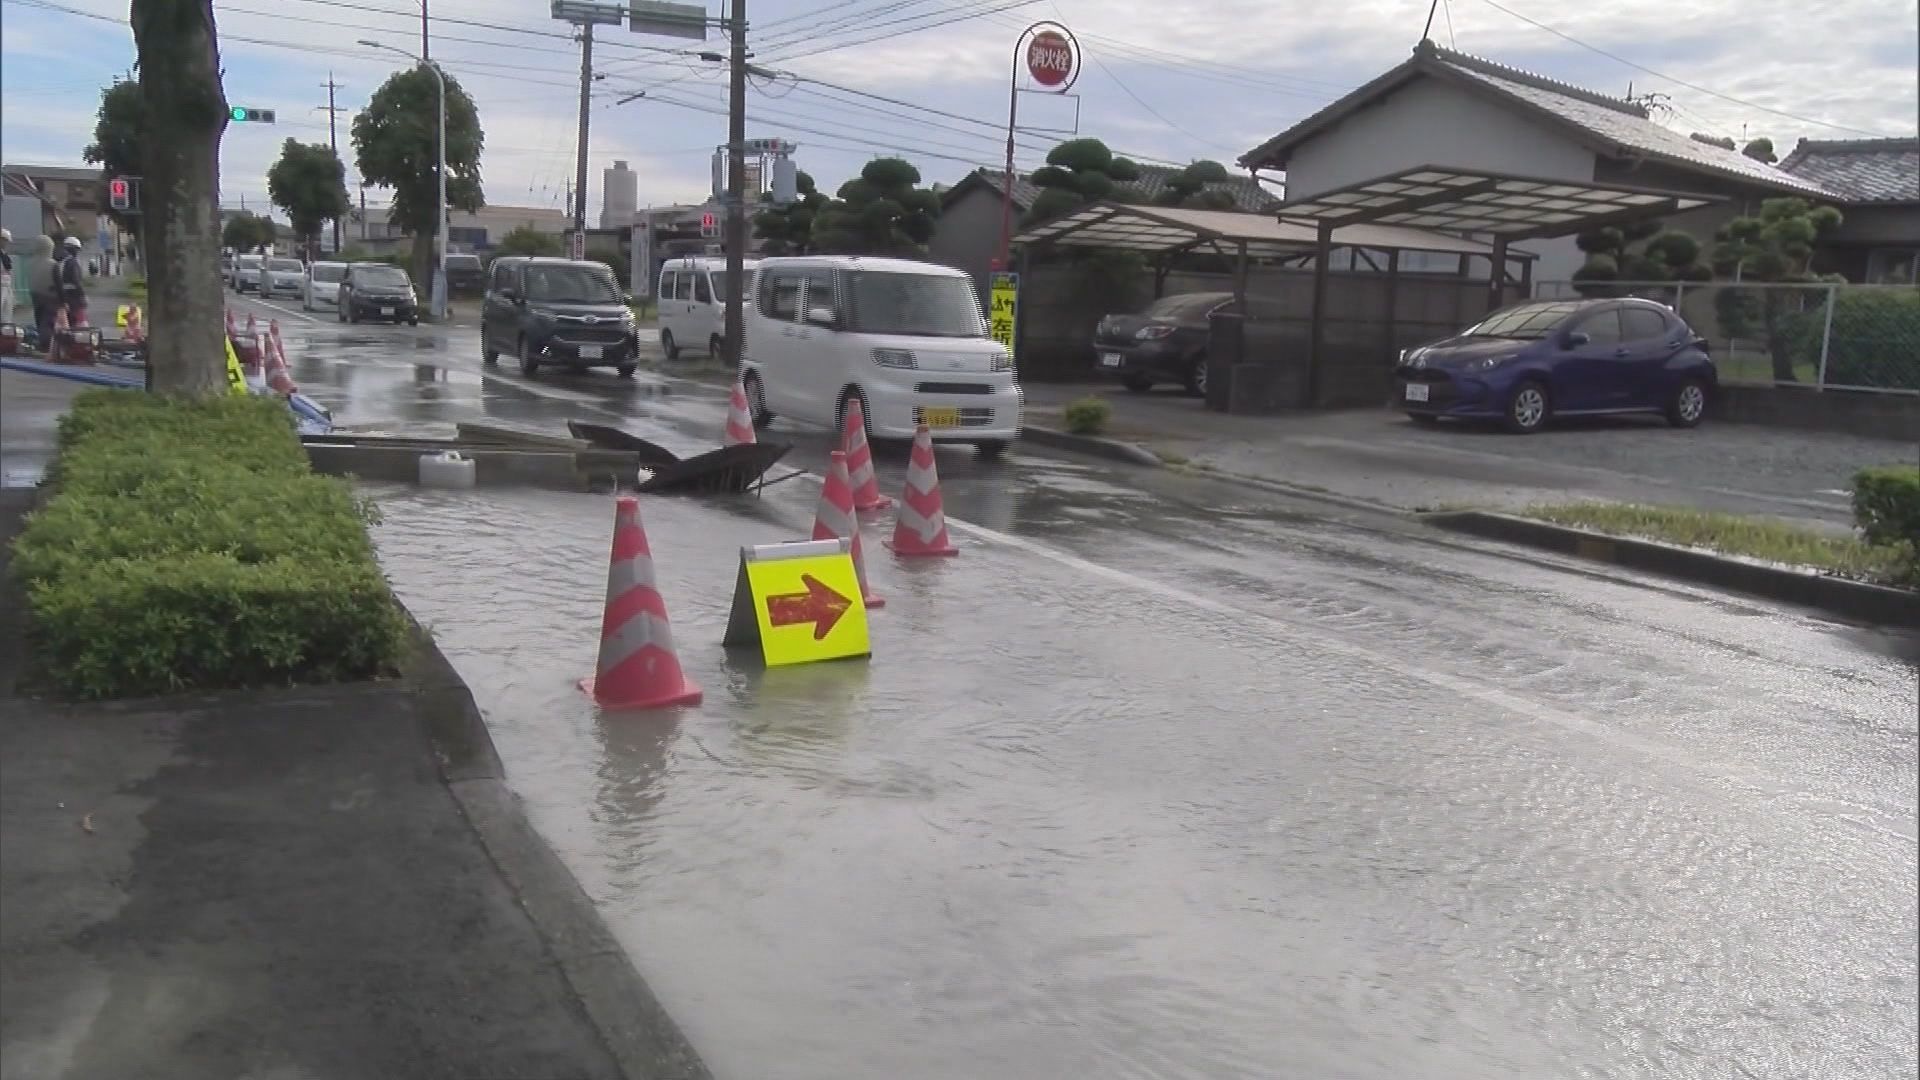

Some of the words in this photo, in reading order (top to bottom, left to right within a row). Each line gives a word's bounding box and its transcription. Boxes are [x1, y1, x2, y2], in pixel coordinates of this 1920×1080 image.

[1031, 45, 1069, 72] 消火栓
[993, 318, 1012, 345] 左折
